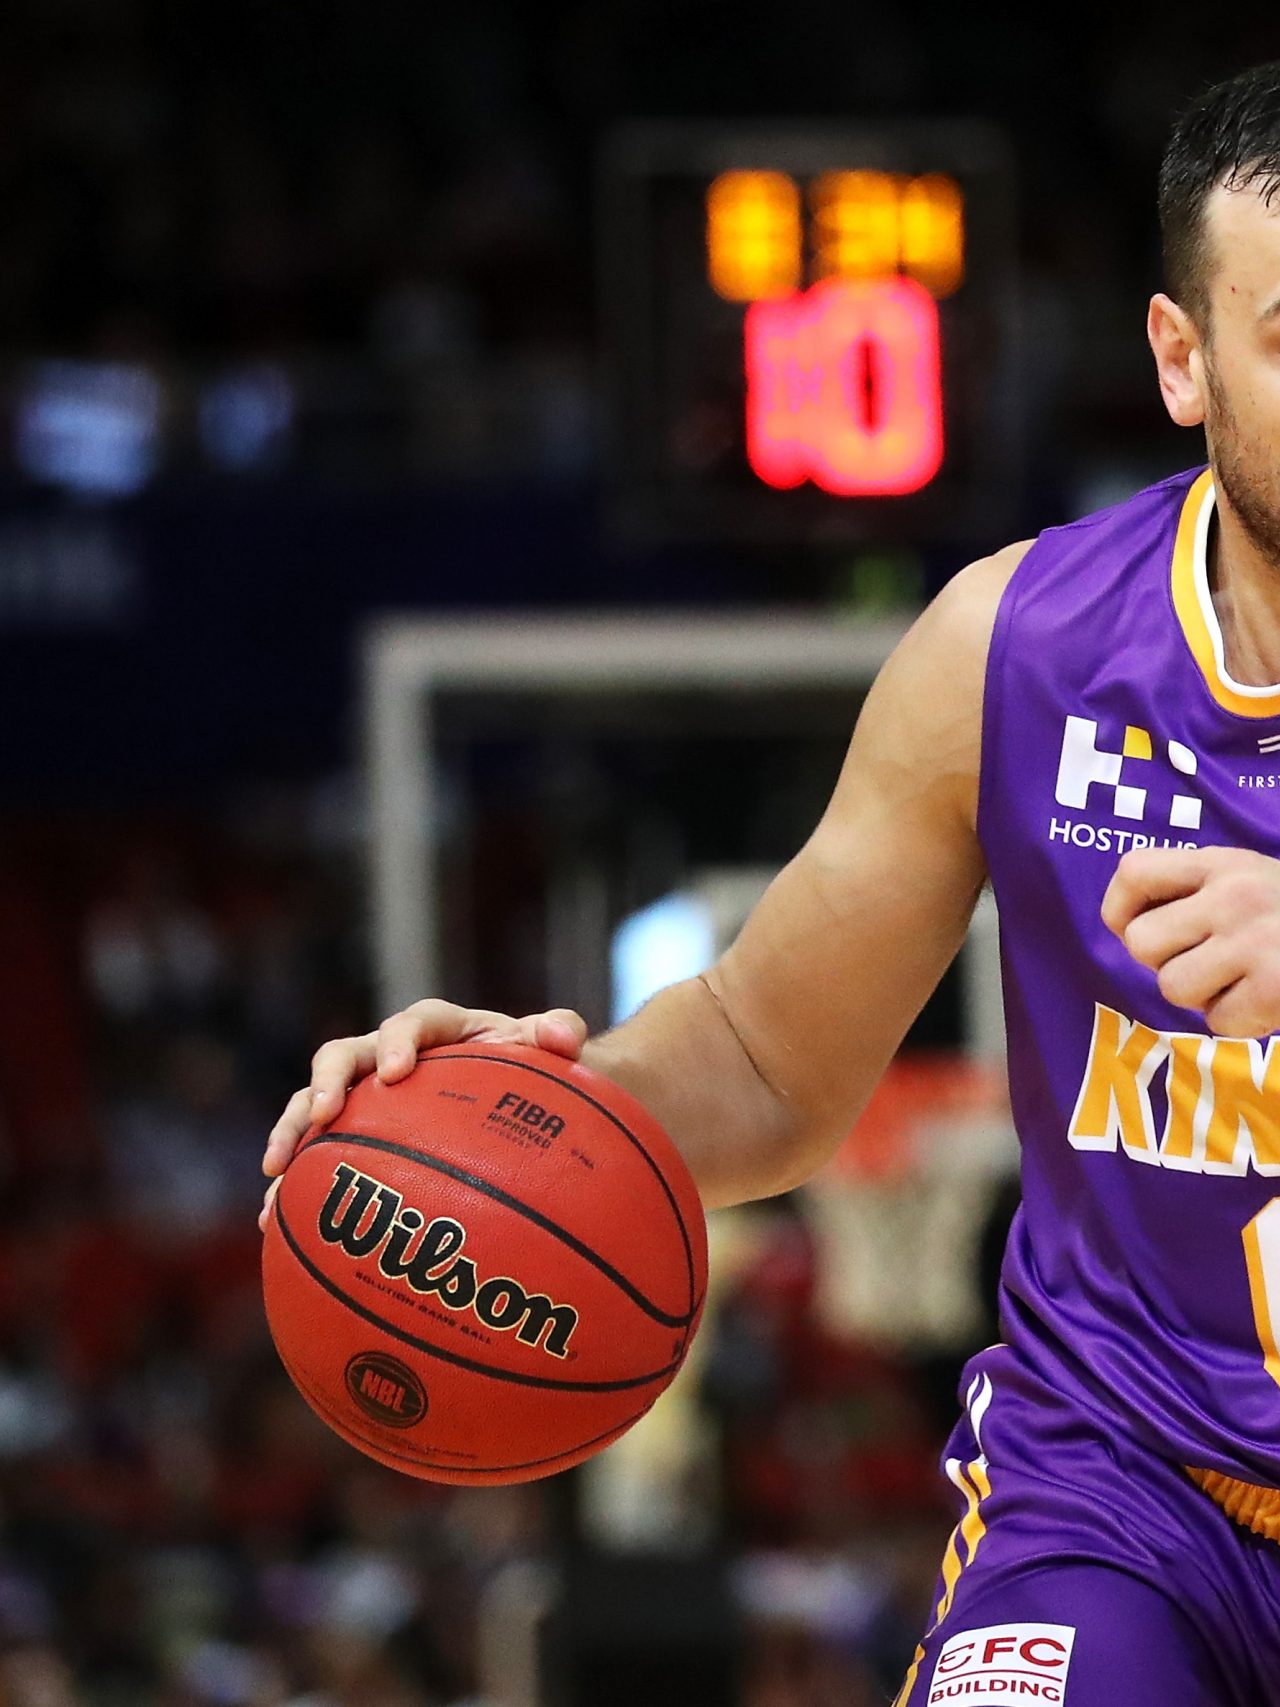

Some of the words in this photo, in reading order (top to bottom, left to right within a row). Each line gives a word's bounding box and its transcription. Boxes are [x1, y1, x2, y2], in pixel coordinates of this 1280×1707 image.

[487, 1112, 551, 1149] APPROVED
[495, 1092, 566, 1138] FIBA
[318, 1162, 579, 1360] Wilson
[354, 1271, 416, 1307] SOLUTION
[419, 1304, 456, 1327] GAME
[460, 1325, 492, 1344] BALL
[360, 1369, 406, 1413] NBL
[930, 1679, 1060, 1704] BUILDING
